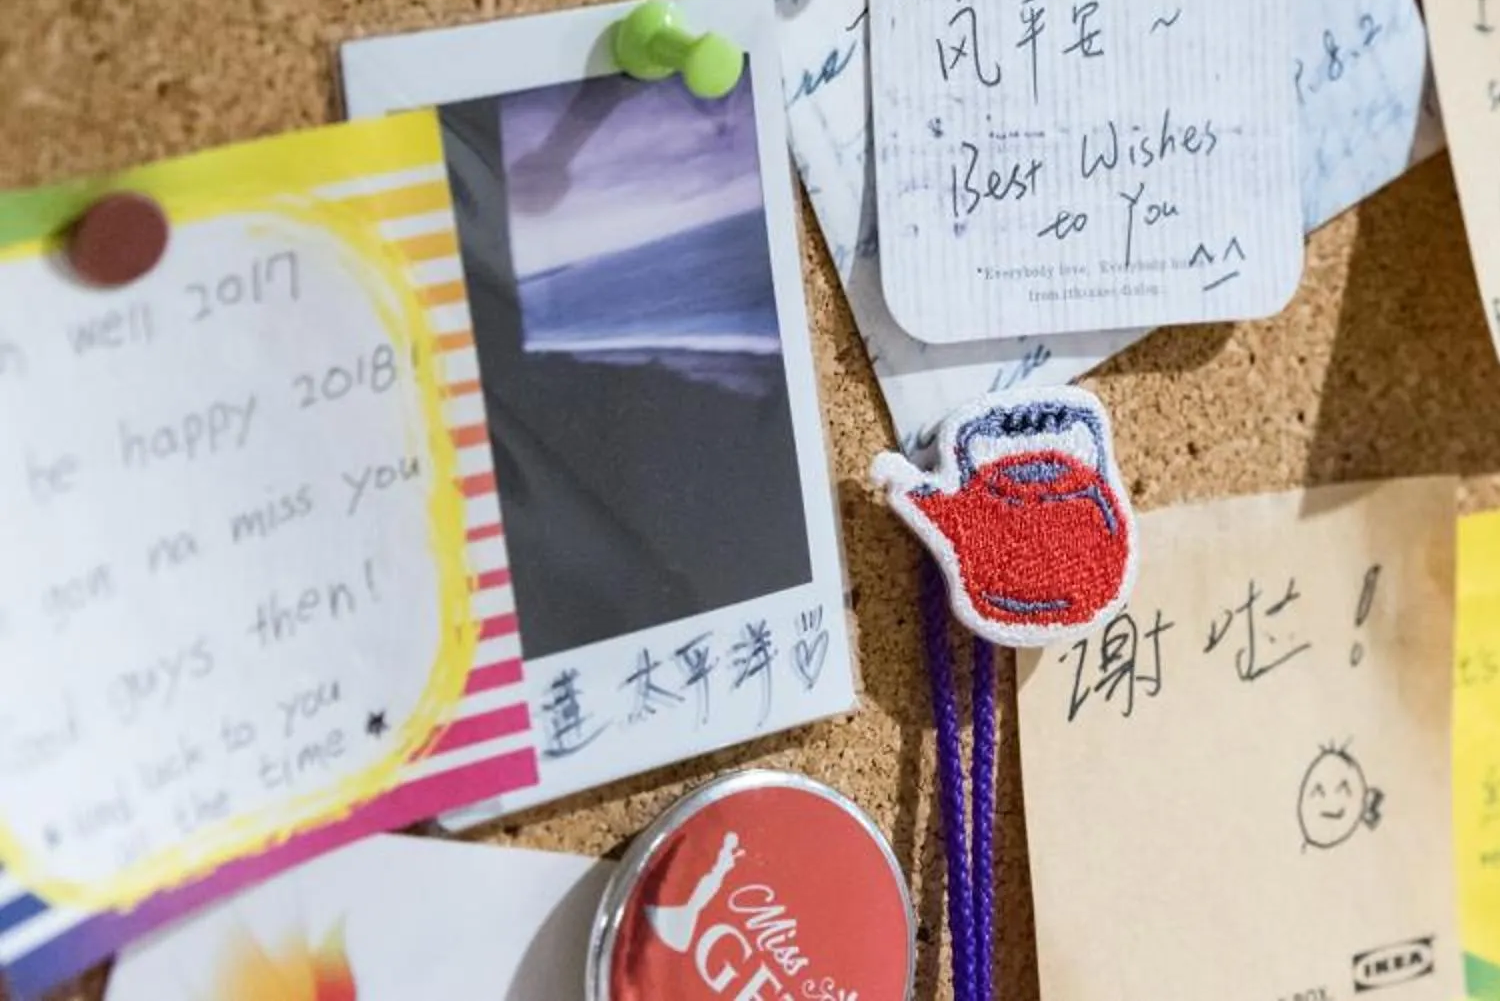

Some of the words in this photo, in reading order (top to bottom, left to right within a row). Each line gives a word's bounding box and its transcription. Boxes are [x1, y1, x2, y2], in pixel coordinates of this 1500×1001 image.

[949, 140, 1044, 217] Best
[1080, 108, 1219, 181] Wishes
[1037, 209, 1089, 240] to
[67, 301, 156, 359] well
[184, 250, 301, 323] 2017
[115, 393, 259, 472] happy
[228, 480, 315, 548] miss
[340, 453, 421, 519] you
[219, 717, 257, 752] to
[276, 678, 342, 727] you
[616, 617, 776, 729] 太平洋
[257, 727, 349, 792] time
[726, 882, 811, 977] Miss
